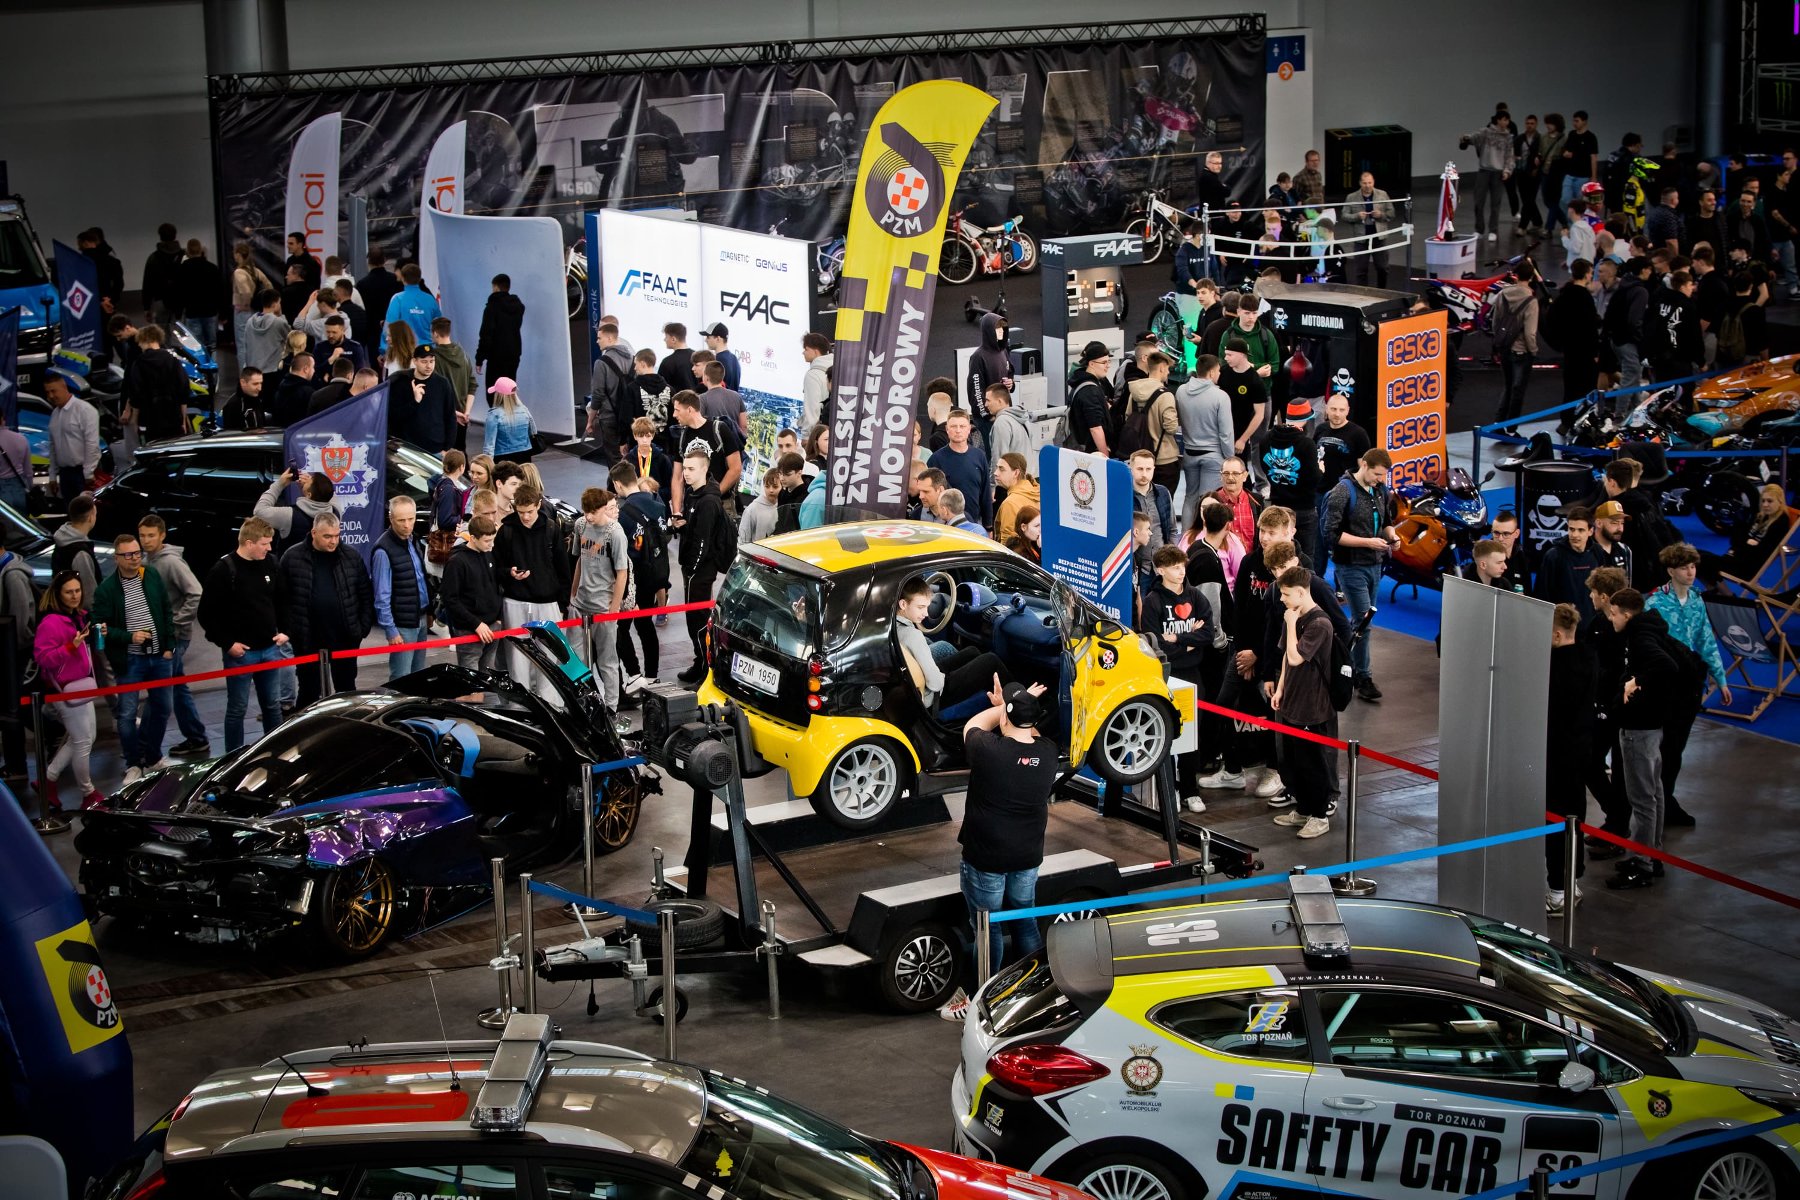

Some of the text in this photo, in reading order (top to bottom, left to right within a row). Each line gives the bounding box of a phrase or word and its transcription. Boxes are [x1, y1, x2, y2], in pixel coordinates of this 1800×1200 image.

[562, 181, 593, 196] 1950
[301, 173, 324, 273] mai
[880, 210, 922, 235] PZM
[1042, 242, 1064, 255] FAAC
[1094, 238, 1143, 258] FAAC
[642, 272, 688, 298] FAAC
[644, 294, 688, 308] TECHNOLOGIES
[720, 291, 790, 325] FAAC
[1301, 314, 1344, 330] MOTOBANDA
[1392, 330, 1440, 364] eska
[1392, 372, 1440, 406] eska
[878, 300, 926, 504] MOTOROWY
[846, 350, 886, 504] ZWIĄZEK
[1392, 414, 1440, 449] eska
[832, 386, 858, 506] POLSKI
[1058, 558, 1098, 575] BEZPIECZEŃSTWA
[1068, 568, 1098, 582] DROGOWEGO
[1078, 557, 1098, 568] KOMISJA
[1066, 576, 1098, 590] RATOWNIKÓW
[739, 660, 777, 686] PZM 1950
[1259, 1031, 1292, 1041] POZNAŃ
[1409, 1109, 1486, 1128] TOR POZNAŃ
[1216, 1103, 1502, 1196] SAFETY CAR
